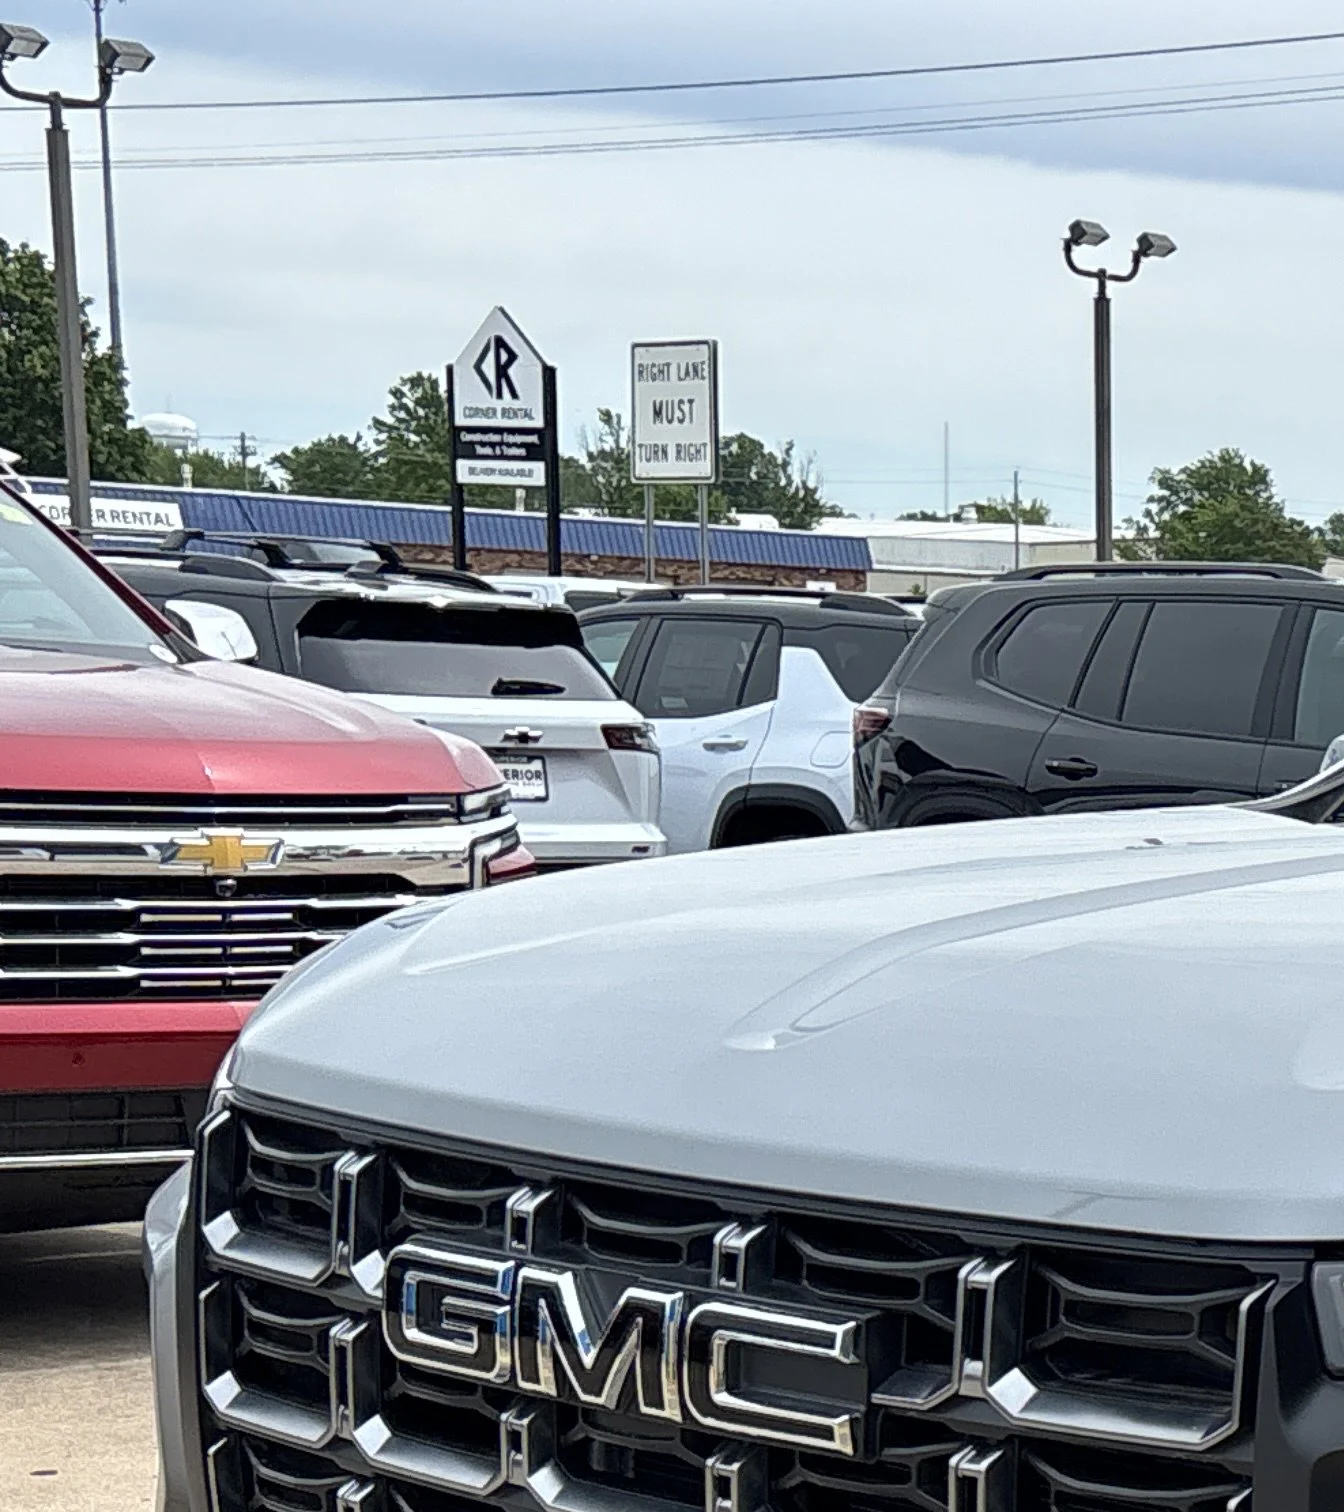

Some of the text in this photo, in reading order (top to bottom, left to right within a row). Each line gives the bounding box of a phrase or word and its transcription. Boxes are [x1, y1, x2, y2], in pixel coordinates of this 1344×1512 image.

[637, 360, 706, 382] RIGHT LANE
[462, 406, 536, 420] CORNER RENTAL
[652, 398, 696, 425] MUST
[637, 442, 708, 463] TURN RIGHT
[109, 508, 176, 527] RENTAL
[382, 1242, 861, 1457] GMC
